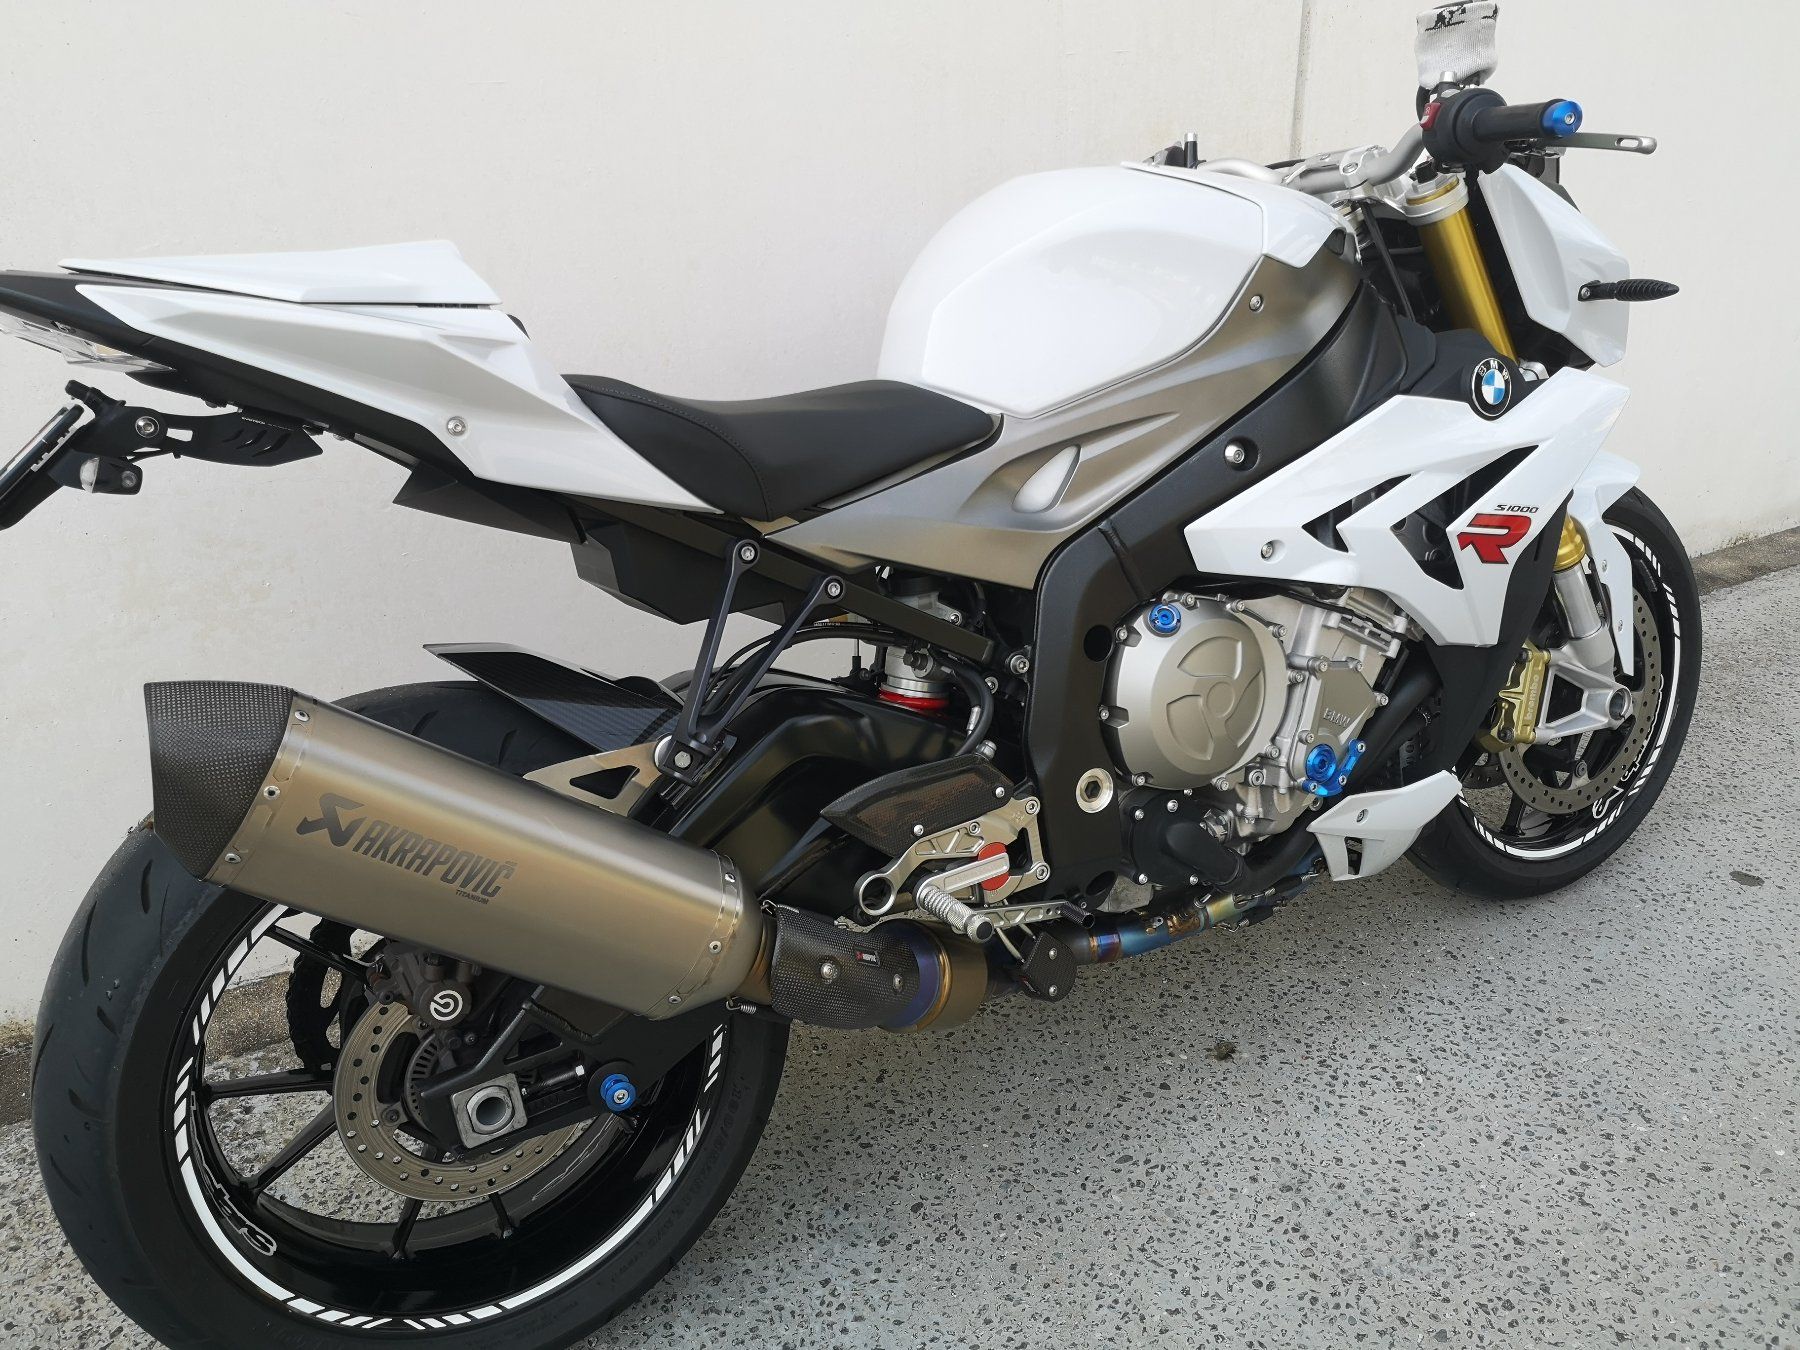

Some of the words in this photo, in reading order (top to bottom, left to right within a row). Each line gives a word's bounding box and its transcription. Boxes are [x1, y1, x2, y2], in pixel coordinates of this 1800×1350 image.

[1478, 360, 1509, 381] BMW
[1494, 504, 1539, 514] S1000
[1457, 513, 1532, 564] R
[1323, 707, 1351, 728] BMW
[455, 889, 489, 905] TITANIUM
